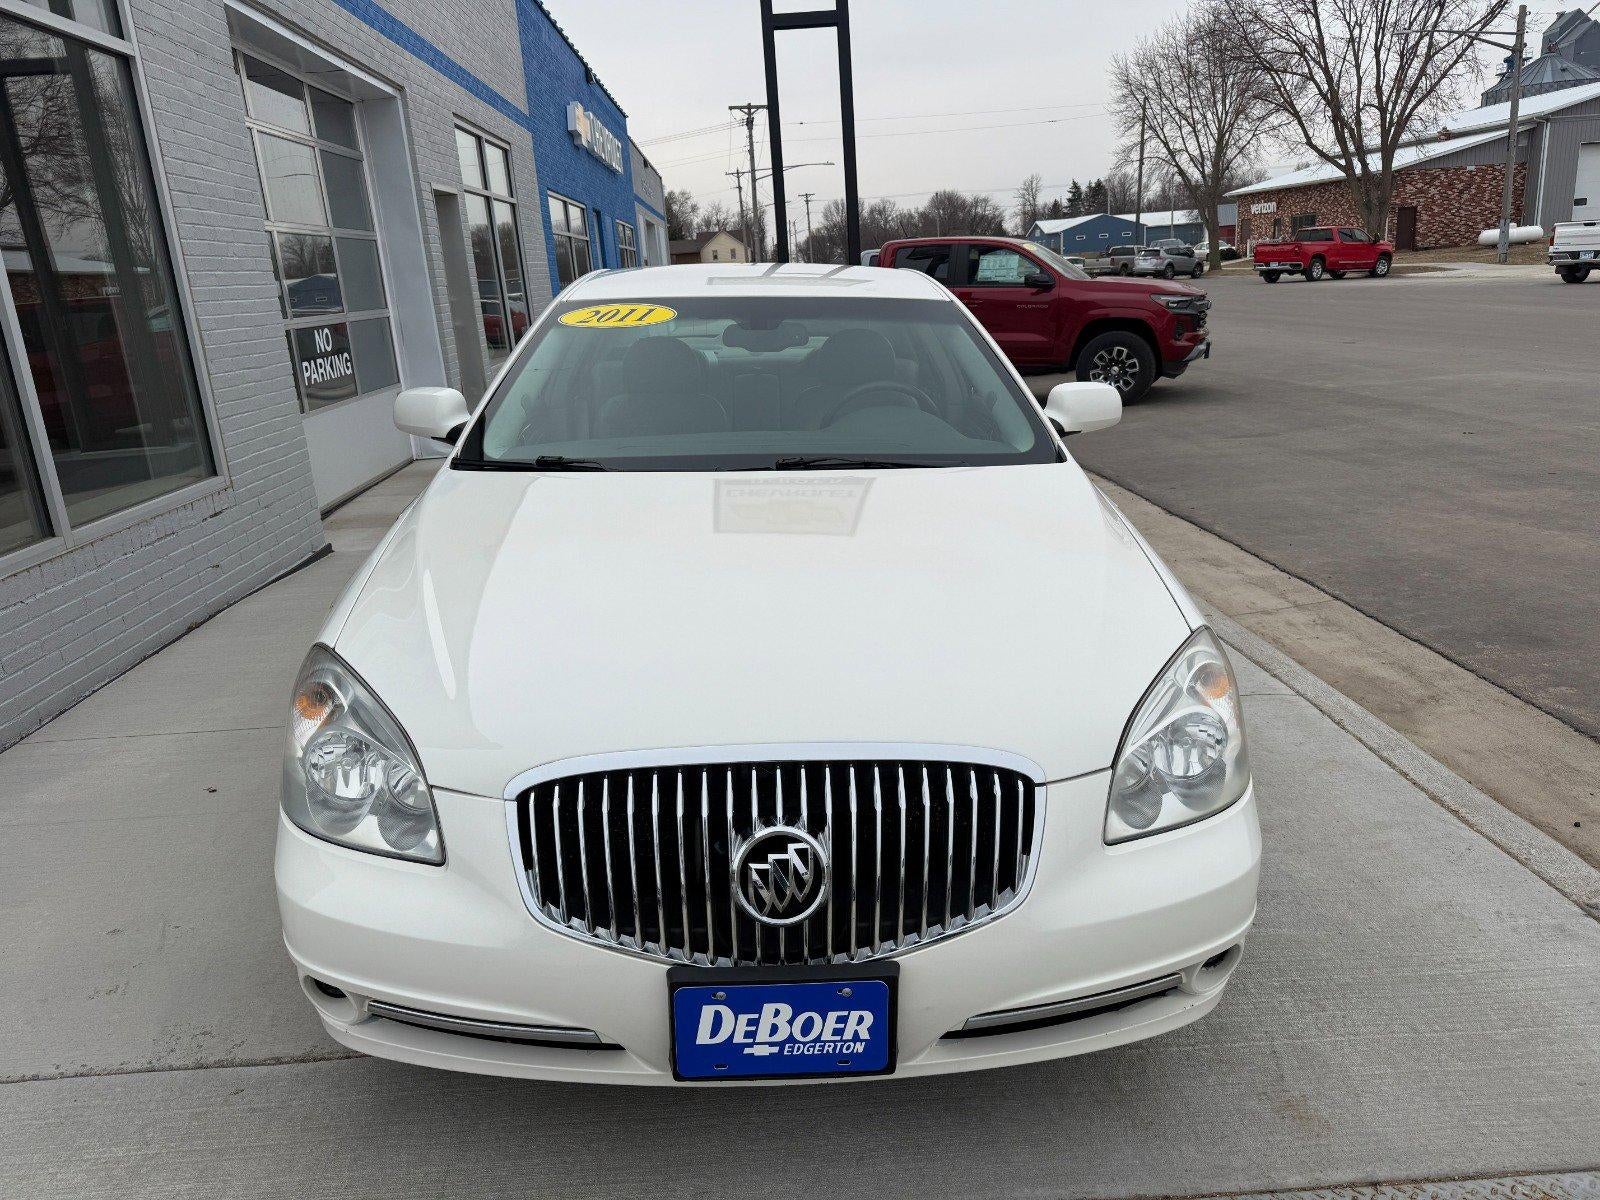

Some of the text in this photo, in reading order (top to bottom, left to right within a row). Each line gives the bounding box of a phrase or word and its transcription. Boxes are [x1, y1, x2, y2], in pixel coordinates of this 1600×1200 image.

[1251, 201, 1276, 214] verizon
[576, 308, 658, 324] 2011
[314, 327, 332, 353] NO
[302, 353, 352, 385] PARKING
[784, 1042, 865, 1055] EDGERTON
